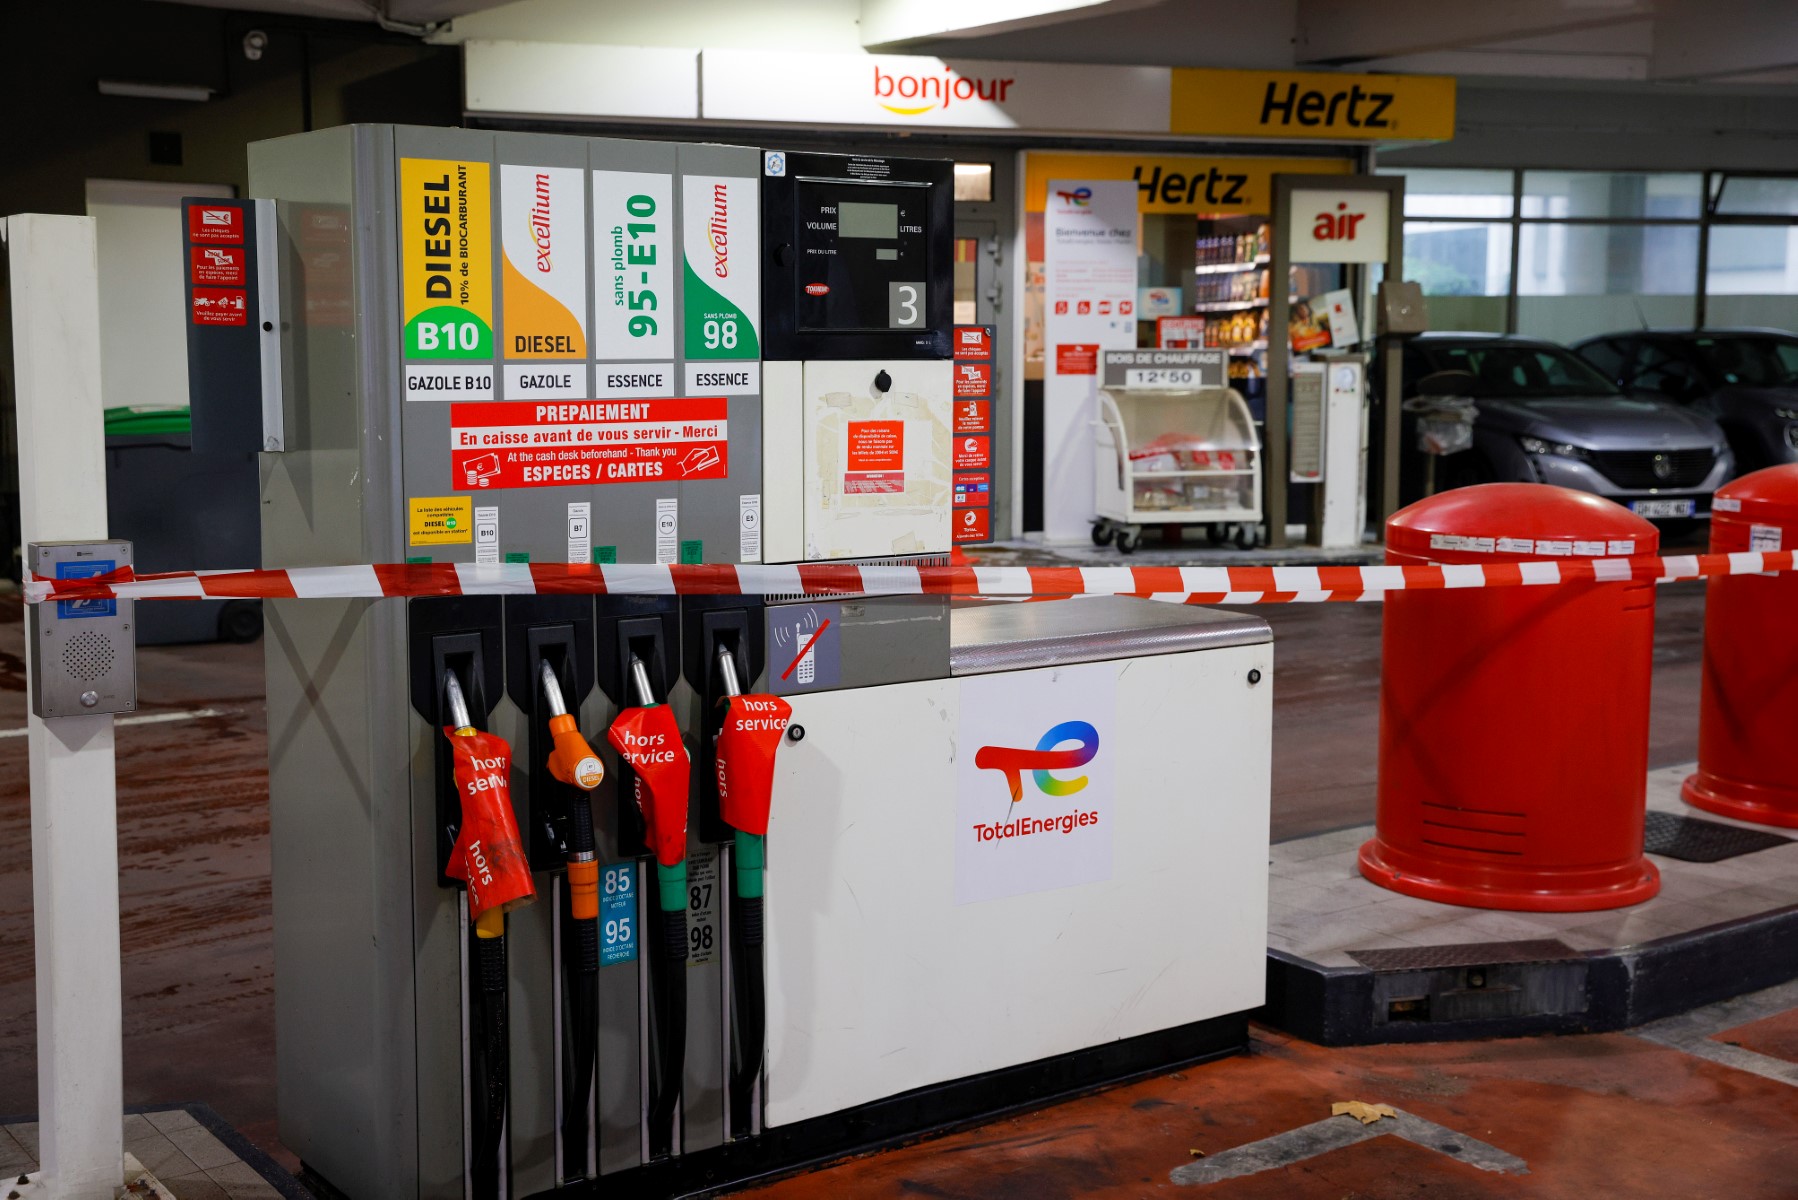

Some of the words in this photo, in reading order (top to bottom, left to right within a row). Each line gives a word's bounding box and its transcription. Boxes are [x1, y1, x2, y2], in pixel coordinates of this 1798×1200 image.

[875, 65, 1015, 109] bonjour
[1260, 82, 1394, 128] Hertz
[1132, 165, 1248, 205] Hertz
[458, 164, 468, 258] BIOCARBURANT
[531, 173, 551, 273] excellium
[820, 206, 836, 214] PRIX
[1313, 202, 1366, 241] air
[424, 174, 452, 299] DIESEL
[710, 183, 728, 279] excellium
[806, 222, 837, 230] VOLUME
[610, 226, 626, 271] plomb
[460, 262, 469, 276] de
[626, 194, 658, 338] 95-E10
[460, 280, 469, 305] 10%
[614, 275, 624, 306] sans
[898, 285, 918, 325] 3
[417, 322, 480, 351] B10
[515, 335, 576, 353] DIESEL
[704, 320, 738, 350] 98
[1106, 352, 1134, 364] BOIS
[1136, 352, 1152, 364] DE
[1154, 352, 1220, 364] CHAUFFAGE
[408, 376, 462, 390] GAZOLE
[465, 376, 492, 390] B10
[520, 375, 572, 389] GAZOLE
[607, 374, 663, 388] ESSENCE
[696, 373, 749, 386] ESSENCE
[536, 403, 650, 422] PREPAIEMENT
[460, 432, 478, 446] En
[482, 431, 529, 445] caisse
[534, 429, 572, 443] avant
[576, 429, 593, 442] de
[598, 430, 628, 440] vous
[633, 426, 672, 439] servir
[682, 425, 718, 438] Merci
[507, 452, 517, 463] At
[520, 452, 534, 462] the
[535, 450, 556, 461] cash
[558, 450, 578, 460] desk
[580, 448, 628, 459] beforehand
[635, 447, 660, 457] Thank
[662, 448, 677, 459] you
[523, 464, 591, 482] ESPECES
[596, 463, 602, 479] /
[607, 461, 663, 478] CARTES
[742, 698, 778, 712] hors
[735, 714, 788, 731] service
[624, 730, 665, 747] hors
[470, 756, 506, 772] hors
[622, 749, 675, 764] ervice
[718, 758, 728, 798] hors
[973, 809, 1098, 842] TotalEnergies
[469, 840, 493, 886] hors
[605, 867, 630, 894] 85
[690, 883, 712, 911] 87
[605, 917, 631, 944] 95
[690, 924, 713, 952] 98
